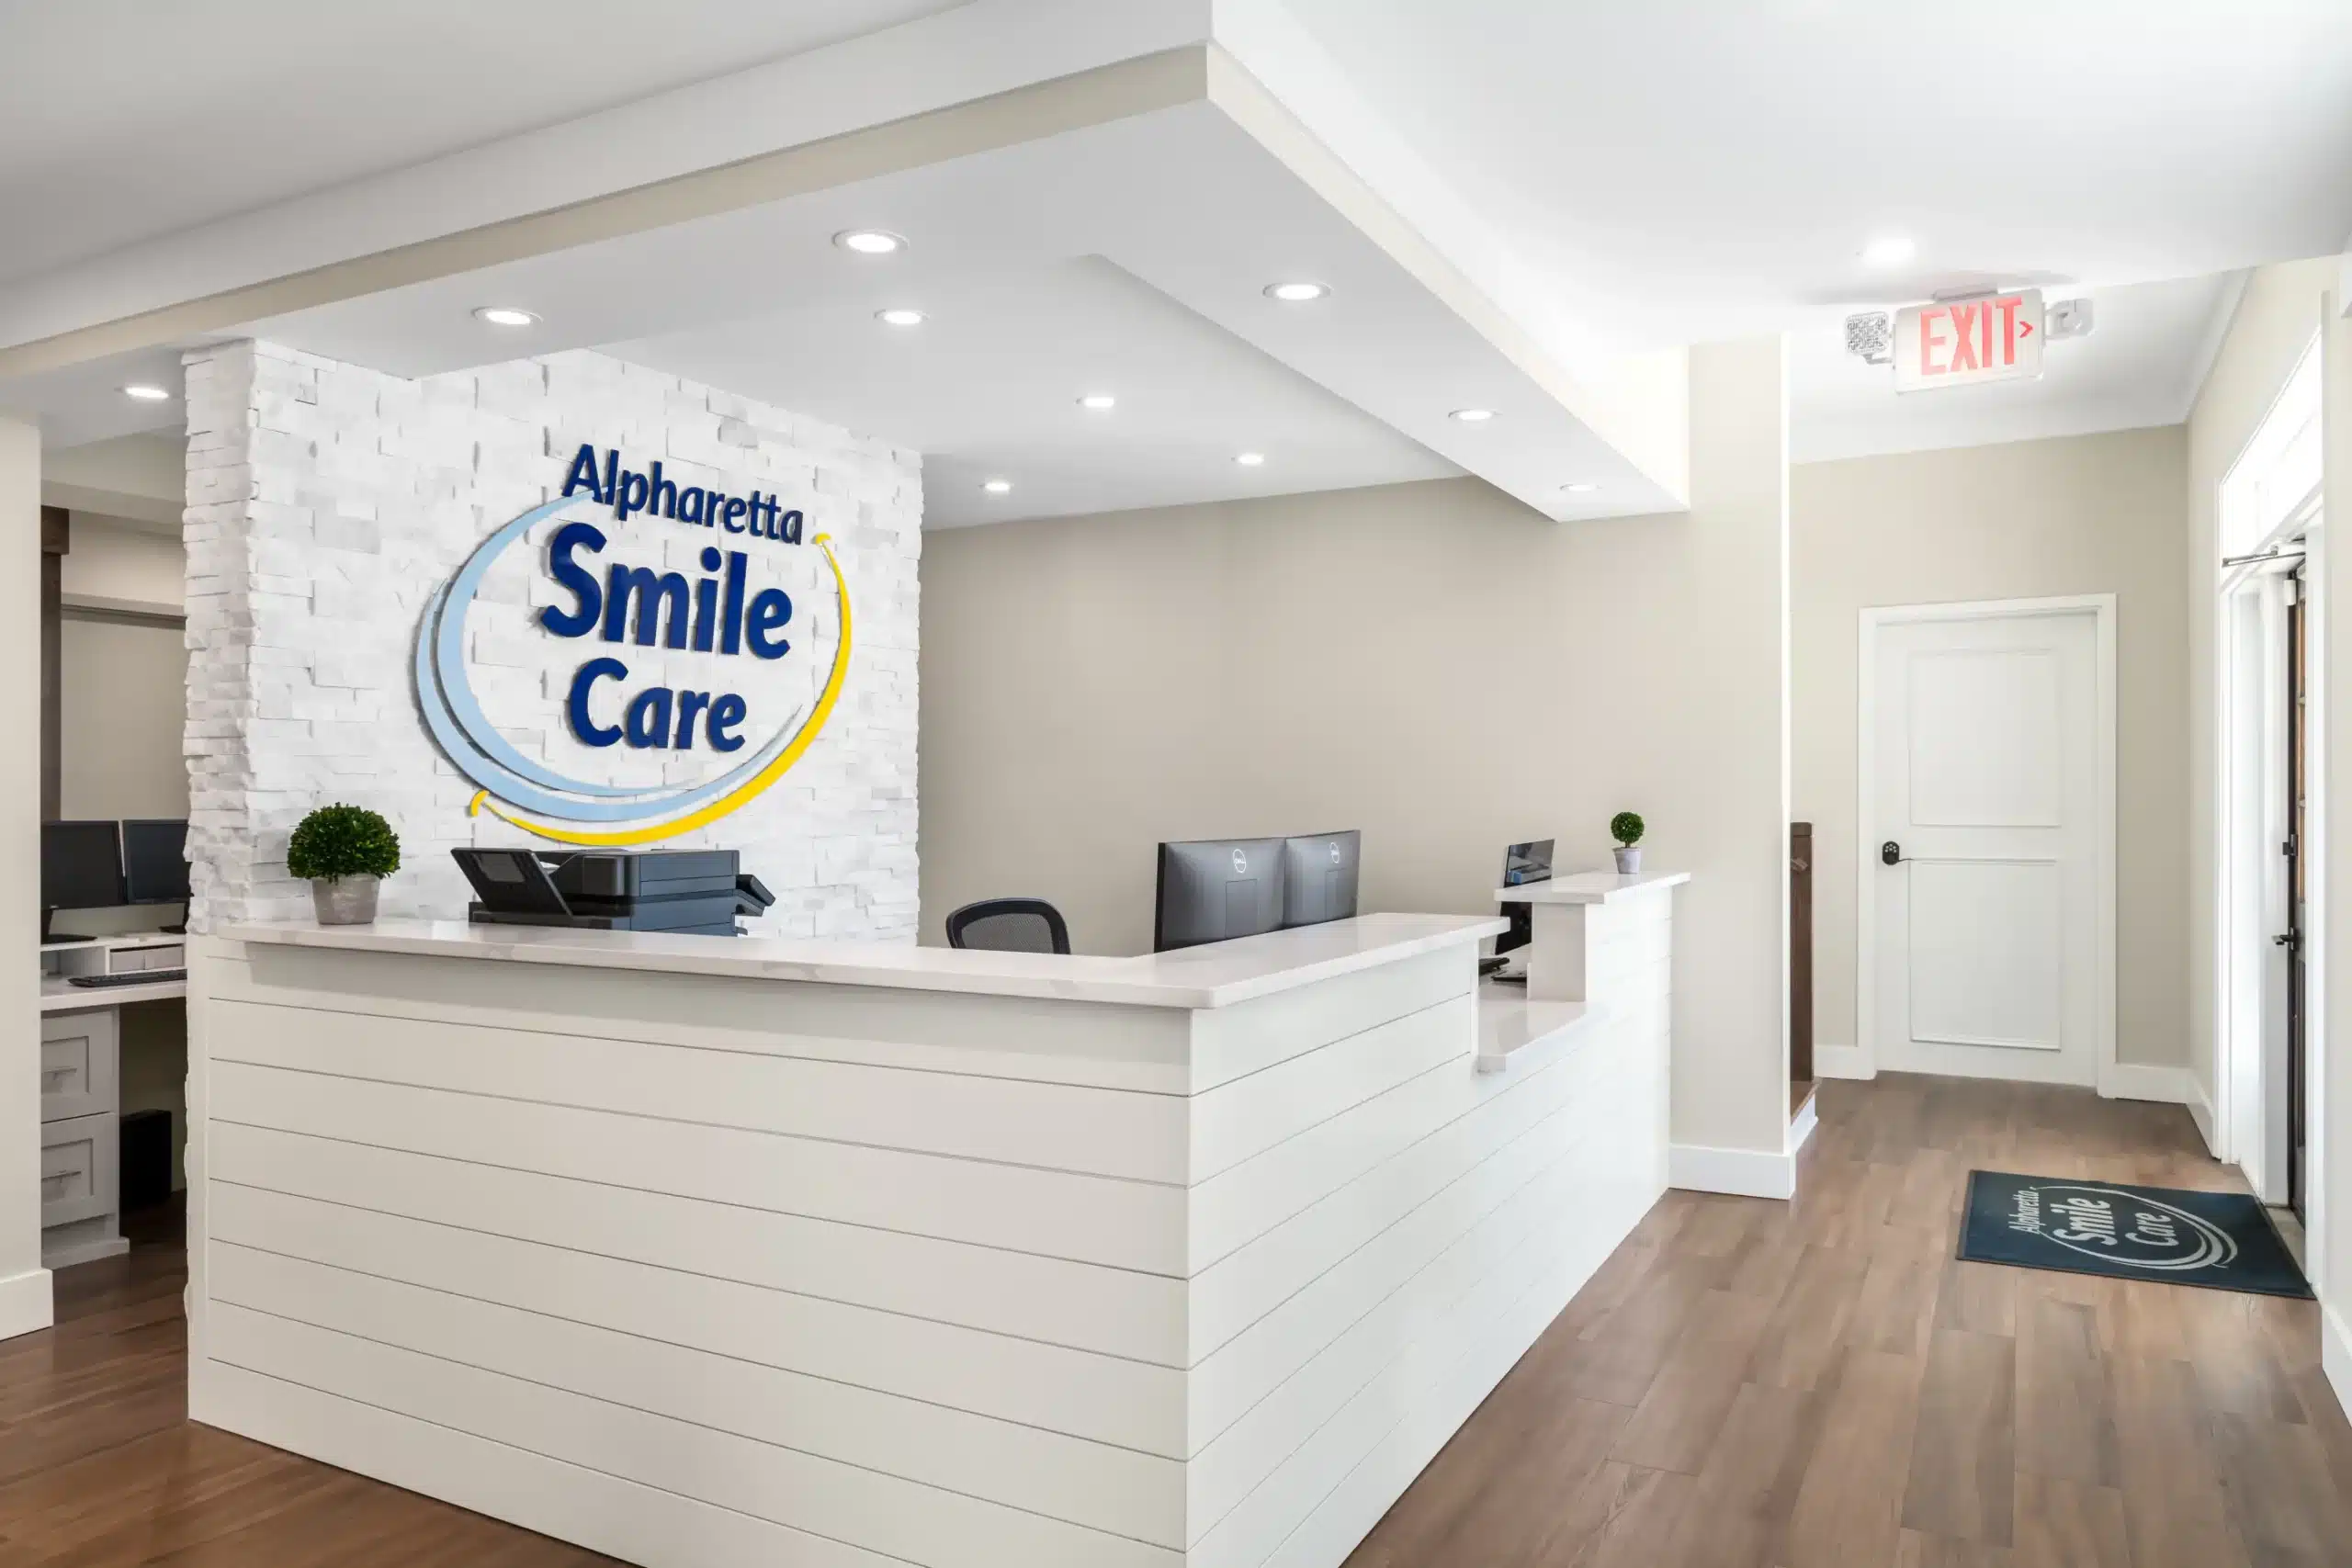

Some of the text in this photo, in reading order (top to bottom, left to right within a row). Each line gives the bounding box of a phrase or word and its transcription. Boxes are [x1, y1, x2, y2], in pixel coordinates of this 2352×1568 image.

[1919, 296, 2023, 376] EXIT
[562, 444, 803, 545] Alpharetta
[541, 522, 793, 660] Smile
[569, 658, 748, 752] Care
[2008, 1190, 2045, 1235] Alpharetta
[2050, 1198, 2118, 1246] Smile
[2125, 1213, 2179, 1247] Care
